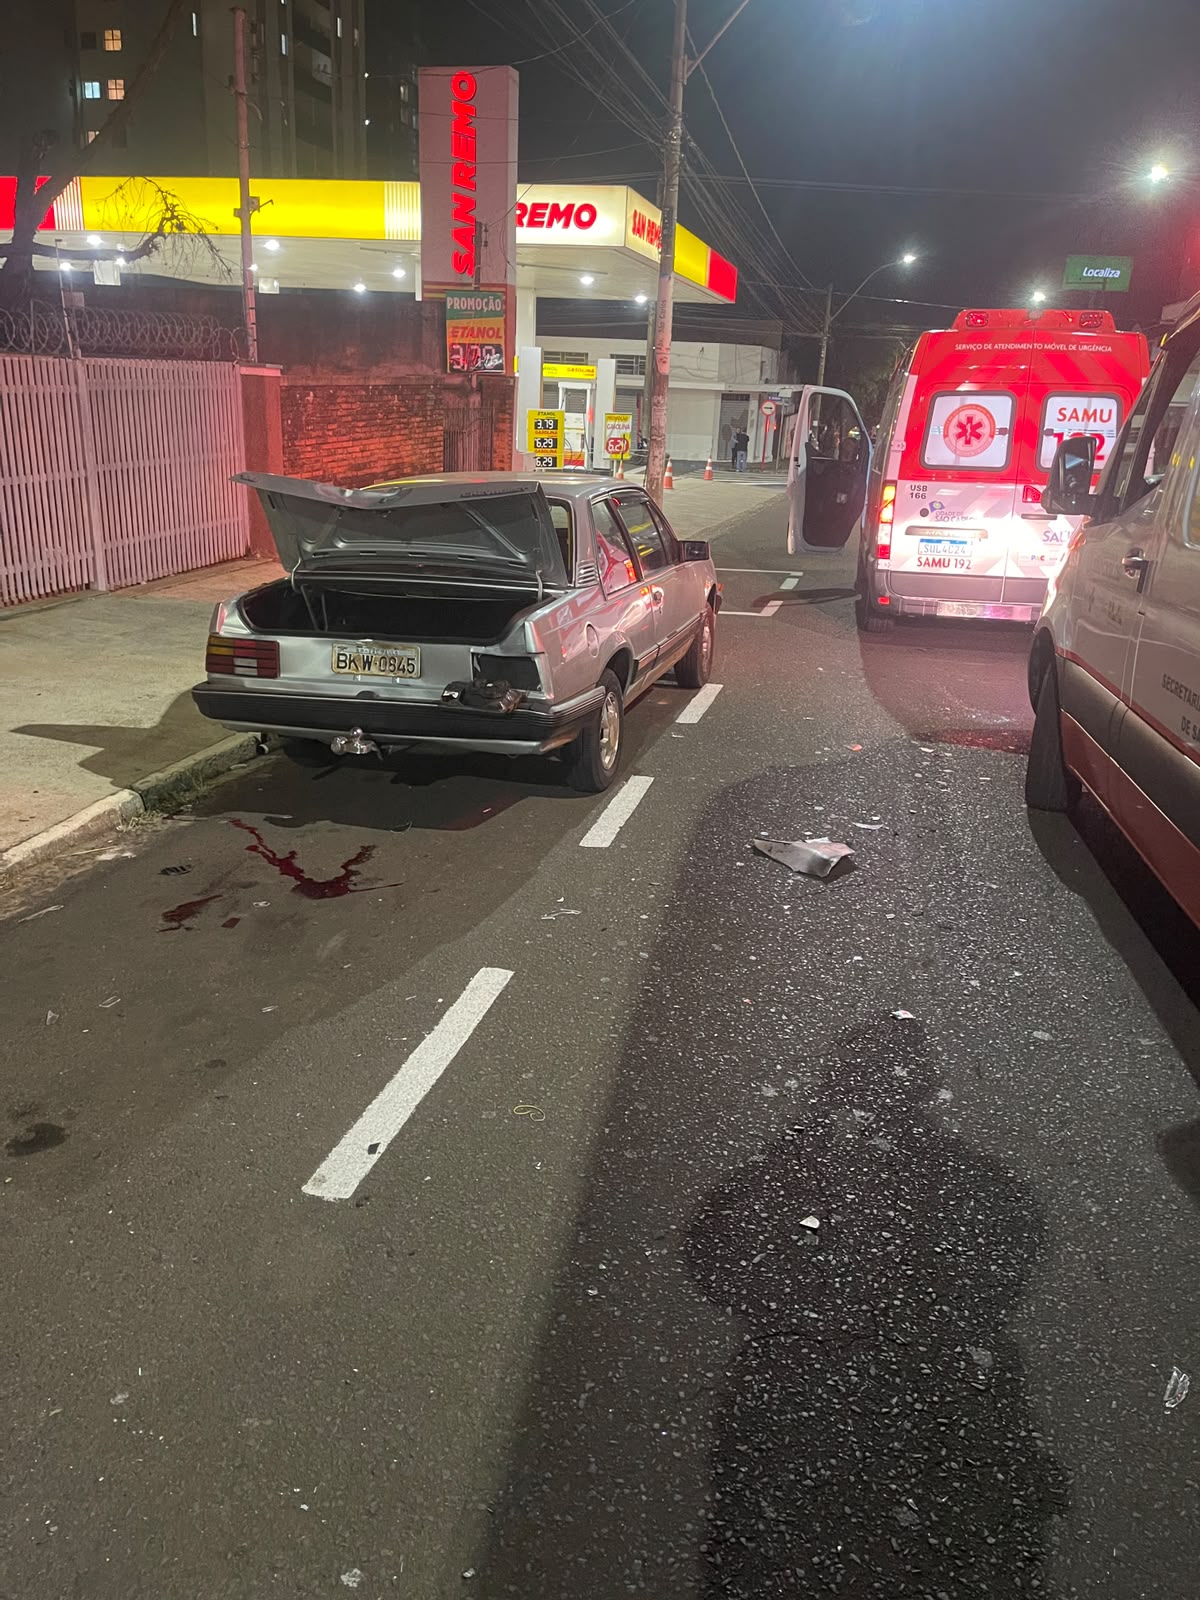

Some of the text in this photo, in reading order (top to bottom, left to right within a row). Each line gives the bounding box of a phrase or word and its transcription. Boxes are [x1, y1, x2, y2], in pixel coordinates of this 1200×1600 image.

[451, 70, 477, 277] SAN REMO
[516, 202, 597, 230] REMO
[632, 209, 646, 240] SAN
[1082, 267, 1121, 278] Localiza
[446, 296, 502, 312] PROMOÇÃO
[450, 326, 502, 339] ETANOL
[955, 343, 982, 351] SERVIÇO
[1044, 342, 1067, 351] MÓVEL
[1079, 344, 1112, 352] URGÊNCIA
[1057, 407, 1112, 423] SAMU
[536, 419, 554, 429] 3,79
[536, 438, 553, 448] 6,29
[536, 457, 553, 467] 6,29
[910, 484, 928, 492] USB
[910, 492, 927, 500] 166
[917, 556, 972, 570] SAMU 192
[1181, 715, 1191, 736] DE
